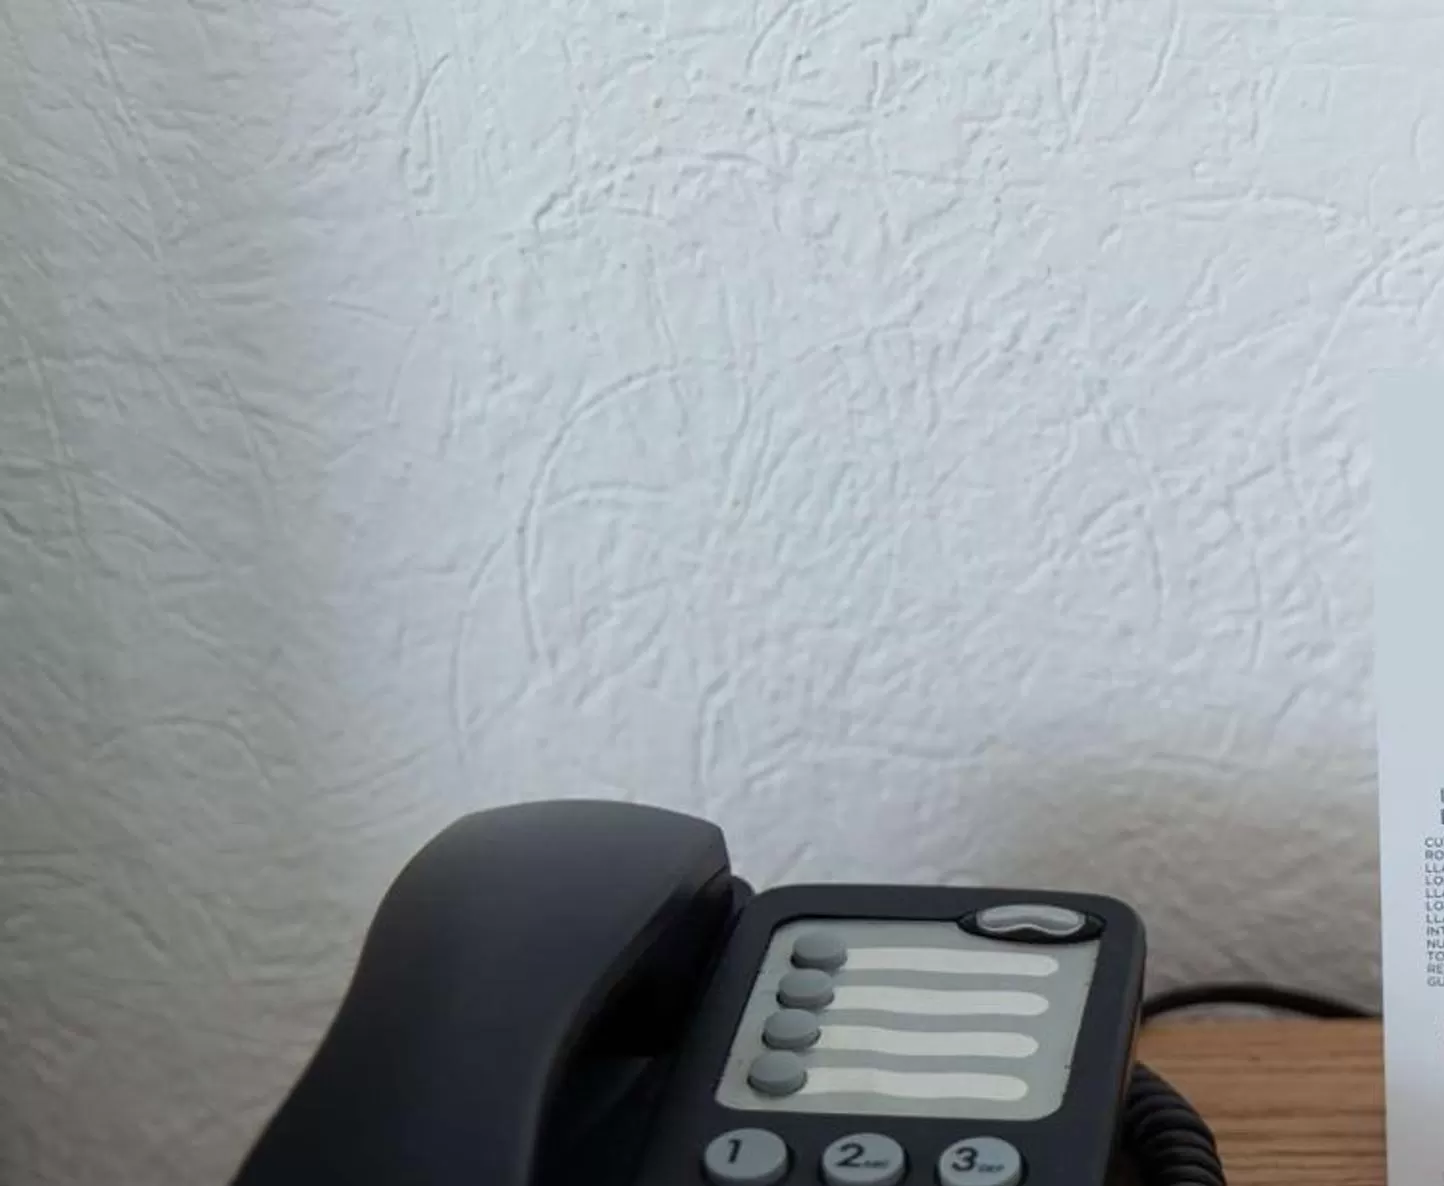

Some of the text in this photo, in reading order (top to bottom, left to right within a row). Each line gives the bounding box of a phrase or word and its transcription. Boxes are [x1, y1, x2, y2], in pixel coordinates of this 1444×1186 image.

[727, 1138, 742, 1164] 1
[836, 1142, 866, 1169] 2
[951, 1146, 978, 1173] 3
